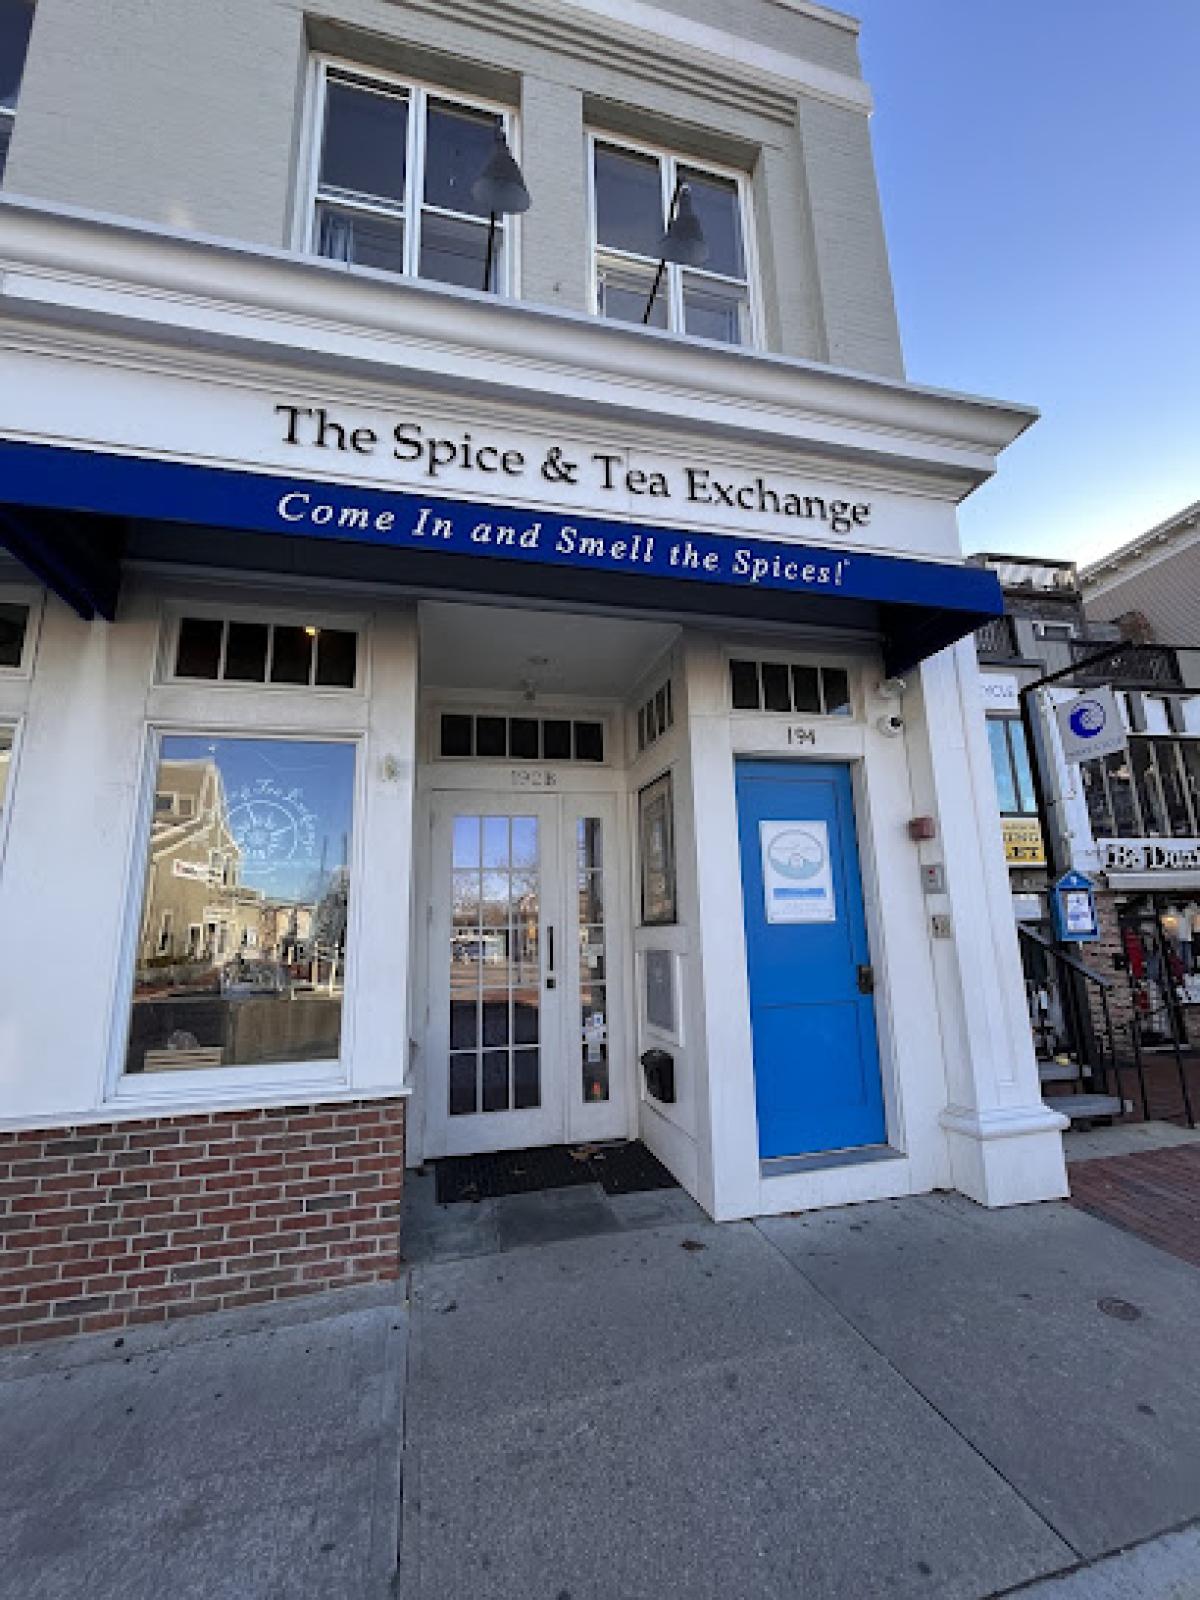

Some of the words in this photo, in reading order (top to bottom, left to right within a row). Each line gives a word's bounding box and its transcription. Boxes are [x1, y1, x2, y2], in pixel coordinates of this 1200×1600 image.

[274, 405, 377, 454] The
[393, 422, 524, 477] Spice
[541, 446, 577, 484] &
[592, 455, 671, 498] Tea
[684, 467, 871, 534] Exchange
[276, 490, 395, 533] Come
[411, 508, 454, 539] In
[470, 523, 542, 548] and
[555, 526, 654, 563] Smell
[669, 541, 720, 573] the
[731, 549, 844, 586] Spices!
[787, 726, 816, 745] 194
